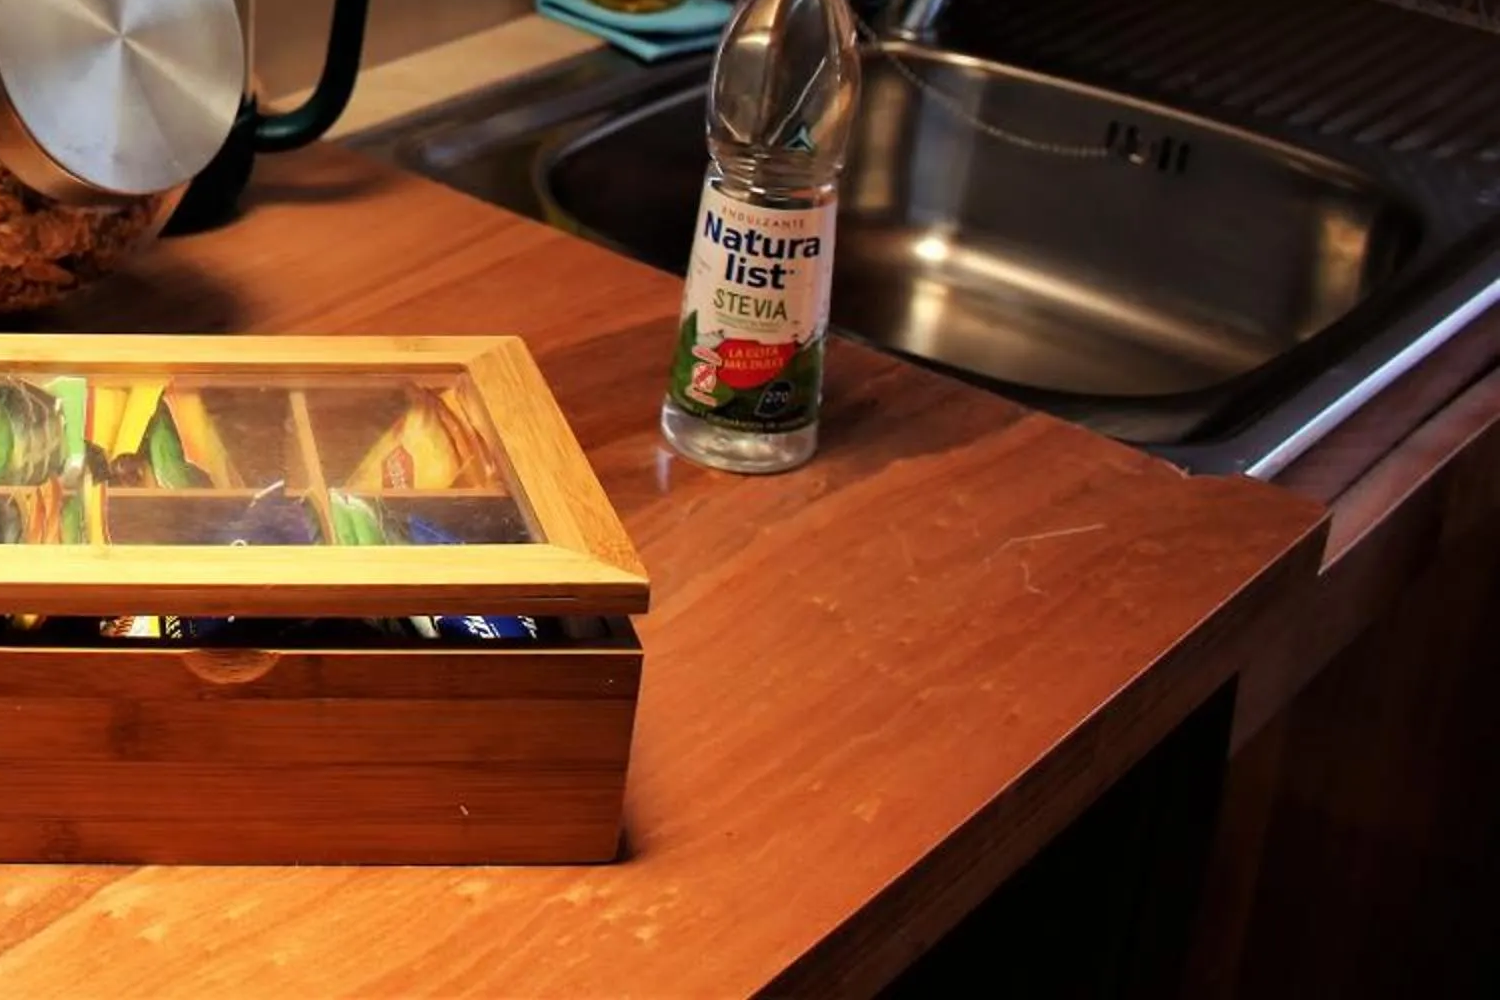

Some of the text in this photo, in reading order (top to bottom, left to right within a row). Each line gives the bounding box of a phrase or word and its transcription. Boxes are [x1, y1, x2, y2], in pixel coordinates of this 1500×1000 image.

[704, 210, 821, 259] Natura
[725, 253, 785, 289] list
[713, 288, 788, 321] STEVIA
